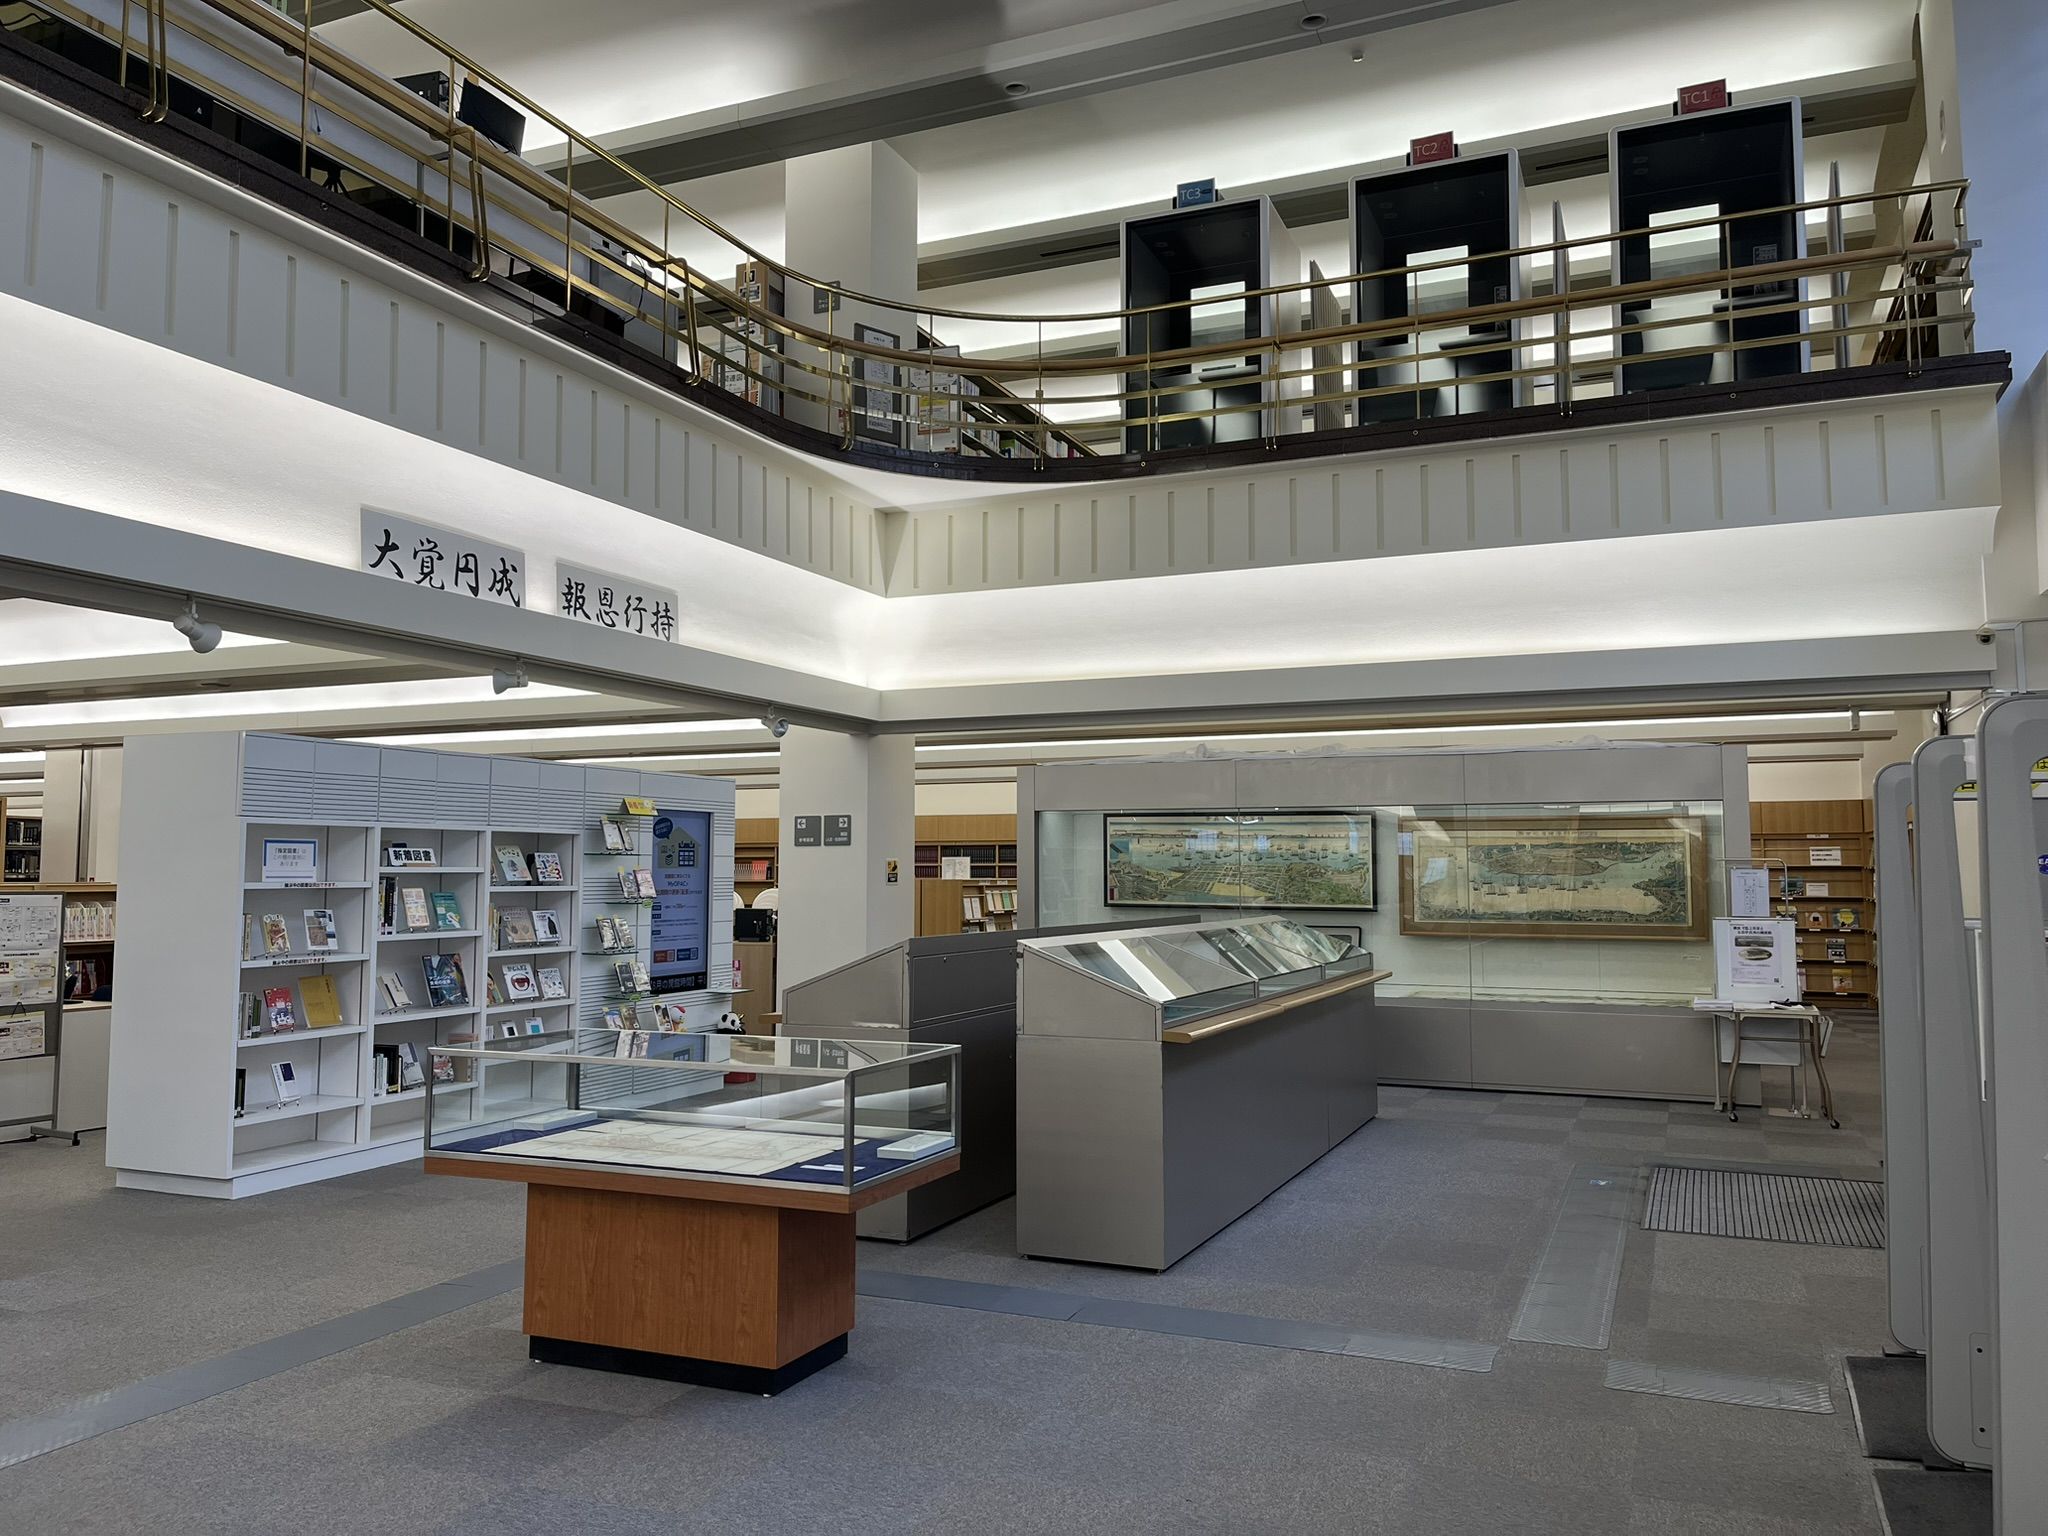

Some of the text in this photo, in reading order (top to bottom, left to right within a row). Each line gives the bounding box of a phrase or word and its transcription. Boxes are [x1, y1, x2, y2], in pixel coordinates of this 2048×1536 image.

[1681, 89, 1710, 106] TC1
[1414, 142, 1438, 157] TC2
[1180, 187, 1201, 201] TC3
[368, 528, 521, 608] 大覚円成
[561, 576, 675, 643] 報恩行持
[392, 849, 432, 862] 新着図書
